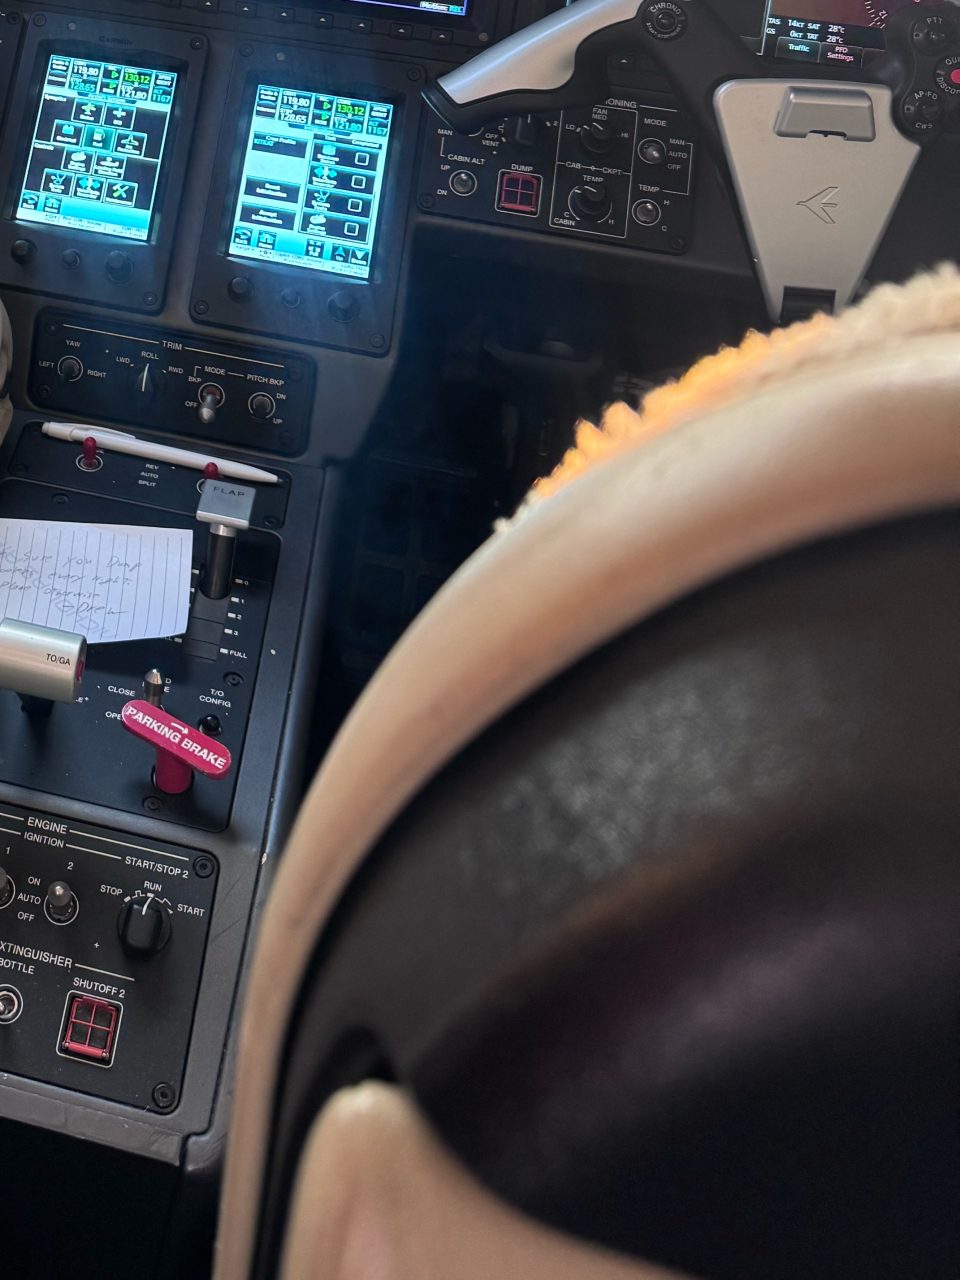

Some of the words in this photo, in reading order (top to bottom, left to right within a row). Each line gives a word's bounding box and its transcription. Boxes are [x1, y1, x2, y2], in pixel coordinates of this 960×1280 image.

[124, 72, 150, 84] 130.12
[282, 95, 310, 107] 119.80
[336, 104, 365, 116] 130.12
[592, 107, 608, 115] FAN
[280, 112, 307, 124] 128.65
[644, 118, 667, 127] MODE
[334, 121, 362, 133] 121.80
[447, 153, 470, 164] CABIN
[470, 157, 486, 166] ALT
[565, 160, 582, 169] CAB
[511, 163, 534, 173] DUMP
[602, 167, 623, 175] CKPT
[582, 175, 604, 184] TEMP
[638, 184, 660, 193] TEMP
[65, 339, 81, 347] YAW
[162, 340, 183, 351] TRIM
[141, 351, 159, 360] ROLL
[38, 360, 55, 368] LEFT
[87, 370, 107, 379] RIGHT
[204, 365, 226, 376] MODE
[247, 373, 268, 384] PITCH
[268, 377, 285, 387] BKP
[213, 485, 246, 497] FLAP
[46, 653, 71, 666] TO/GA
[229, 649, 248, 659] FULL
[108, 685, 136, 697] CLOSE
[210, 688, 225, 697] T/O
[199, 695, 231, 708] CONFIG
[105, 711, 122, 720] OPE
[125, 706, 181, 744] PARKING
[180, 739, 227, 769] BRAKE
[27, 816, 68, 834] ENGINE
[23, 831, 64, 848] IGNITION
[6, 846, 11, 855] 1
[67, 862, 74, 870] 2
[125, 856, 181, 877] START/STOP
[182, 870, 189, 879] 2
[27, 876, 41, 886] ON
[143, 881, 163, 892] RUN
[100, 884, 123, 896] STOP
[17, 892, 41, 905] AUTO
[177, 904, 205, 917] START
[17, 911, 35, 922] OFF
[73, 977, 118, 996] SHUTOFF
[118, 989, 126, 998] 2
